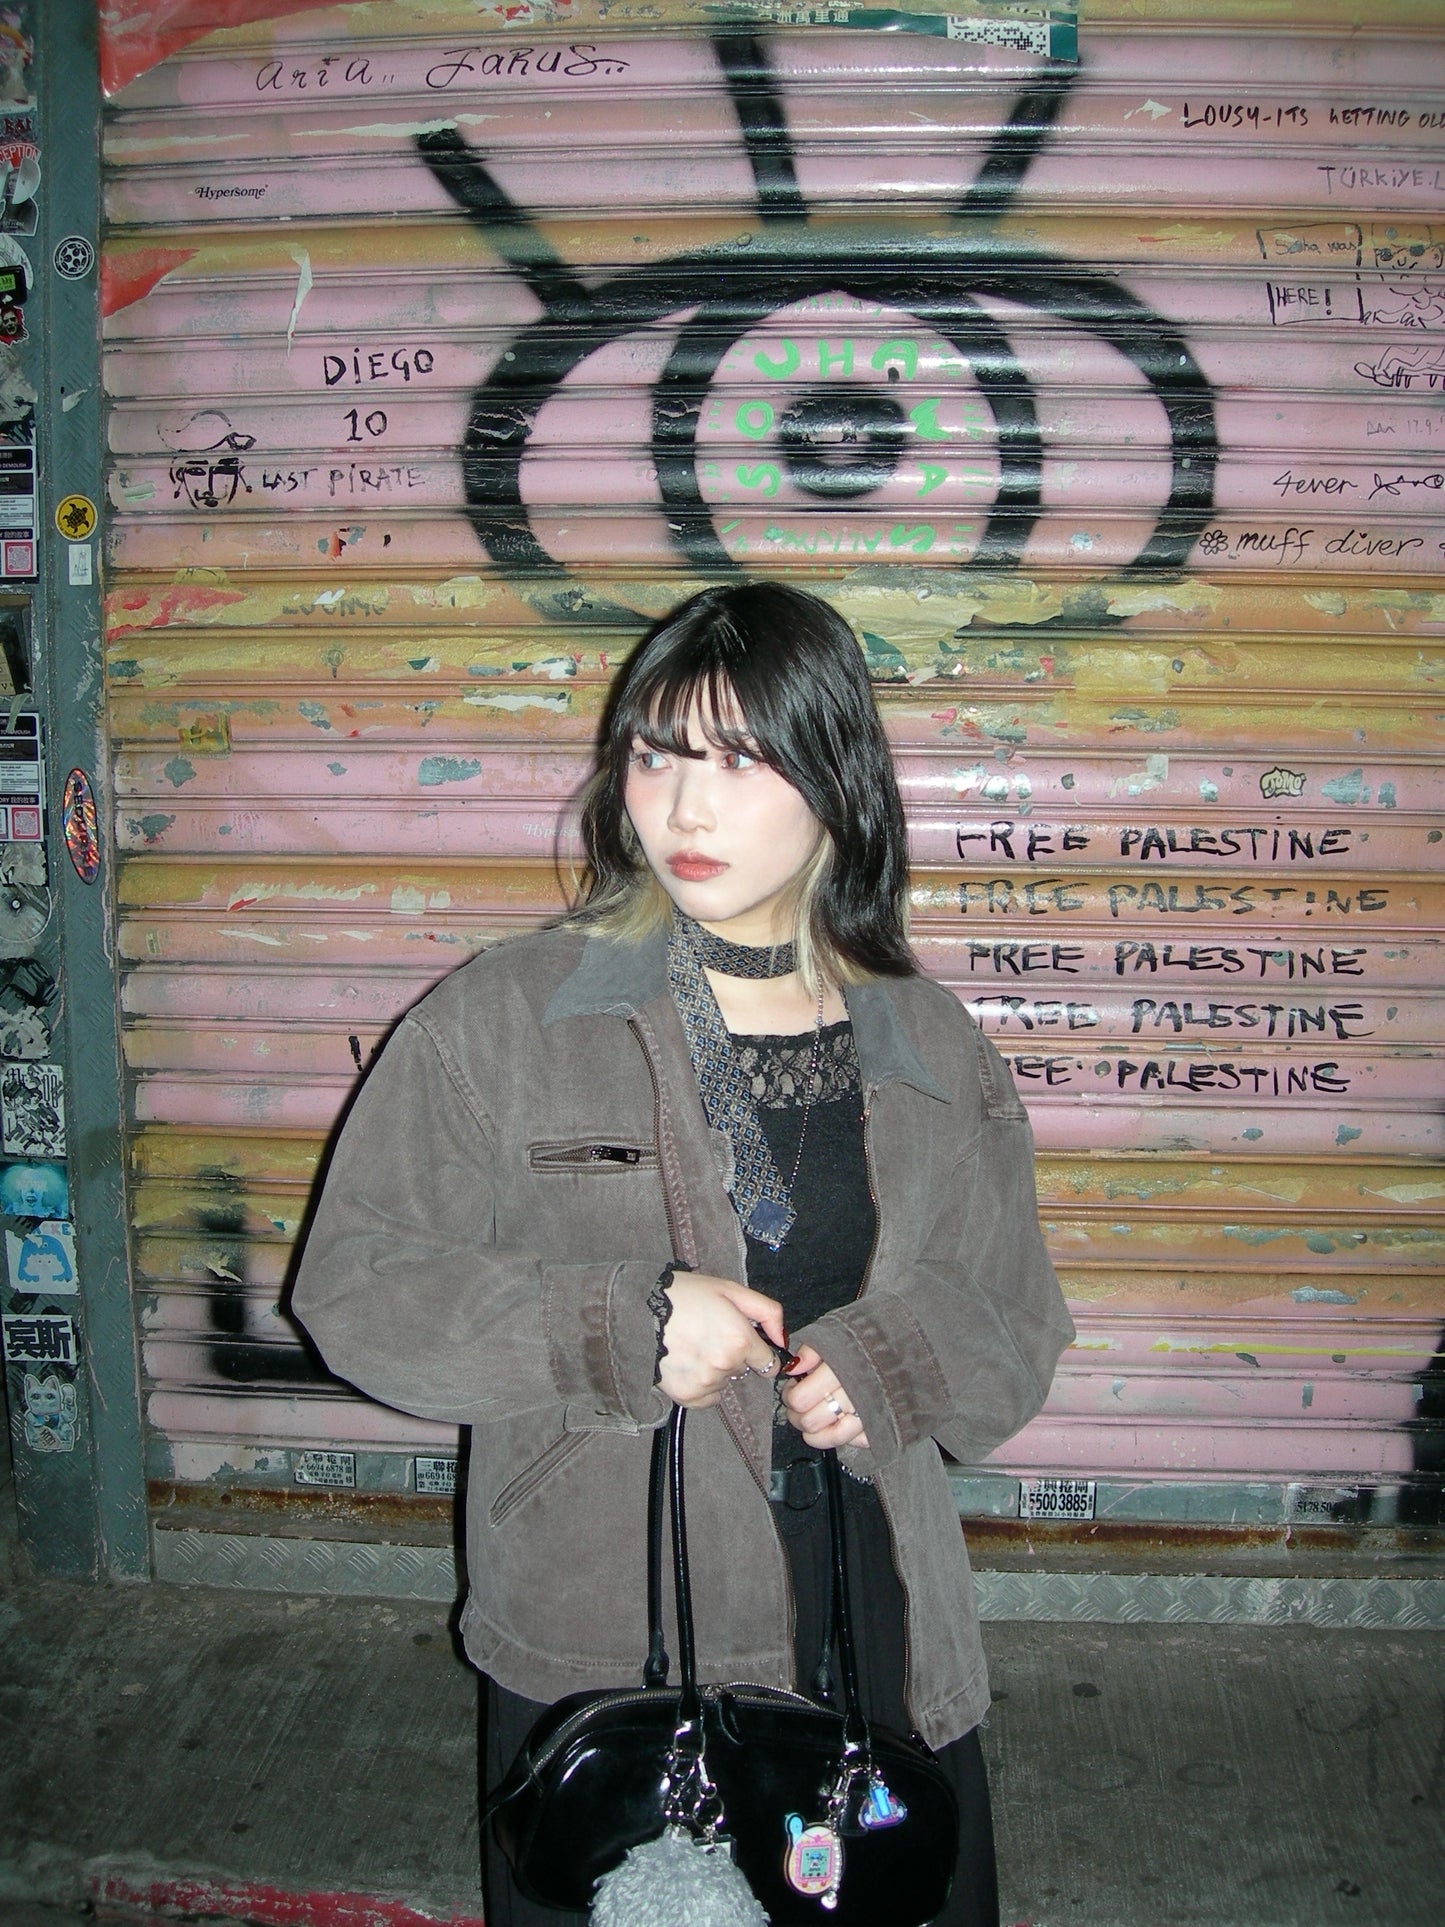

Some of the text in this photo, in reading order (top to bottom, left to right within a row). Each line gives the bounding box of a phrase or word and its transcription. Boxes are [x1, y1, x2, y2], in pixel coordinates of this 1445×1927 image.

[343, 408, 388, 441] 10
[1273, 470, 1358, 497] 4ever
[1236, 527, 1424, 566] muff diver
[956, 820, 1352, 861] FREE PALESTINE
[959, 879, 1389, 917] FREE PALESTINE
[966, 940, 1367, 979] FREE PALESTINE
[1131, 998, 1376, 1039] PALESTINE
[1001, 1055, 1351, 1096] EE PALESTINE
[1029, 1493, 1057, 1511] 5500
[1058, 1493, 1088, 1512] 3885
